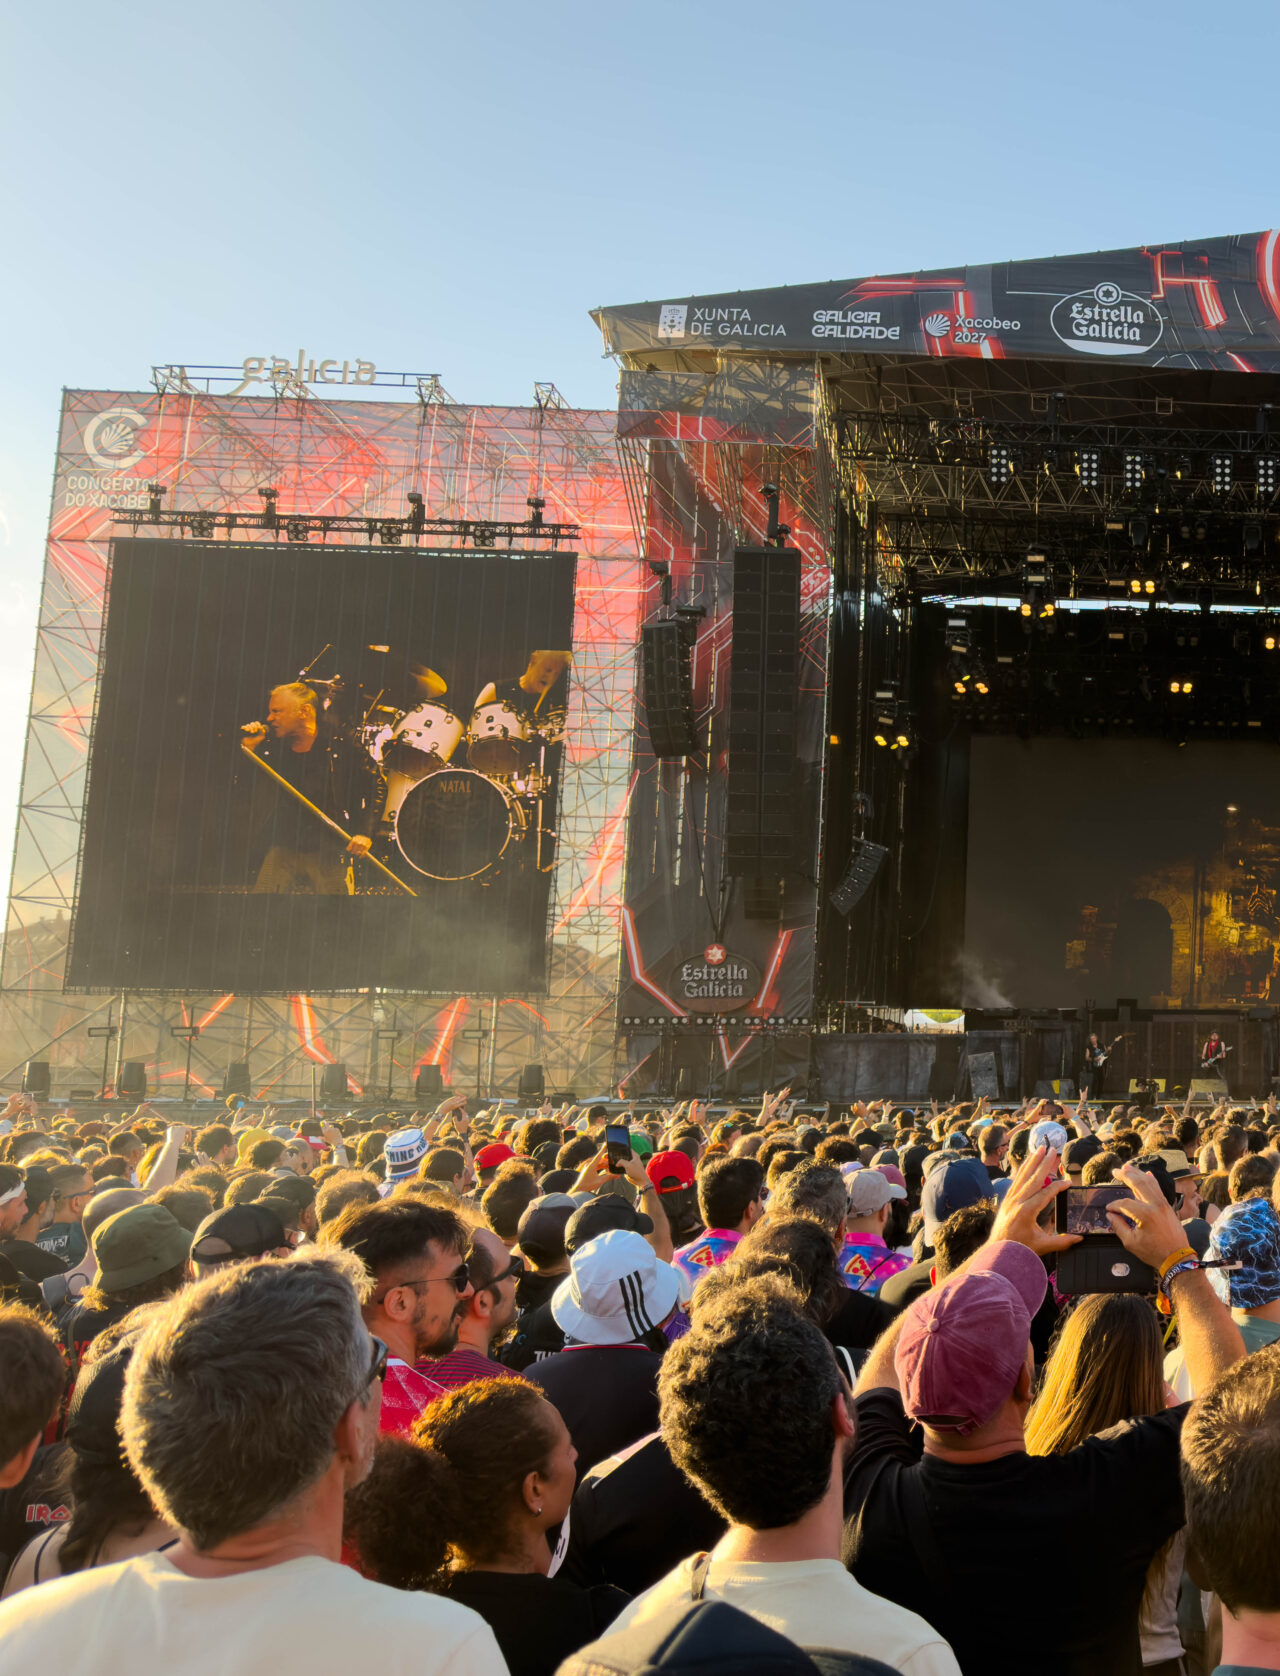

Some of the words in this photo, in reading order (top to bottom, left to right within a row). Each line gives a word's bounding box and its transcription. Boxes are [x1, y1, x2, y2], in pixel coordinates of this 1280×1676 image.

[693, 308, 751, 321] XUNTA
[813, 310, 880, 324] GALICIA
[1070, 303, 1144, 324] Estrella
[691, 322, 713, 336] DE
[718, 323, 787, 336] GALICIA
[955, 315, 1021, 330] Xacobeo
[1072, 319, 1141, 341] Galicia
[811, 324, 900, 340] CALIDADE
[954, 331, 987, 343] 2027
[230, 349, 377, 396] galicia
[65, 493, 85, 507] DO
[89, 493, 151, 510] XACOBE
[440, 780, 472, 792] NATAL
[681, 964, 748, 981] Estrella
[684, 981, 743, 998] Galicia
[25, 1504, 73, 1526] IRO
